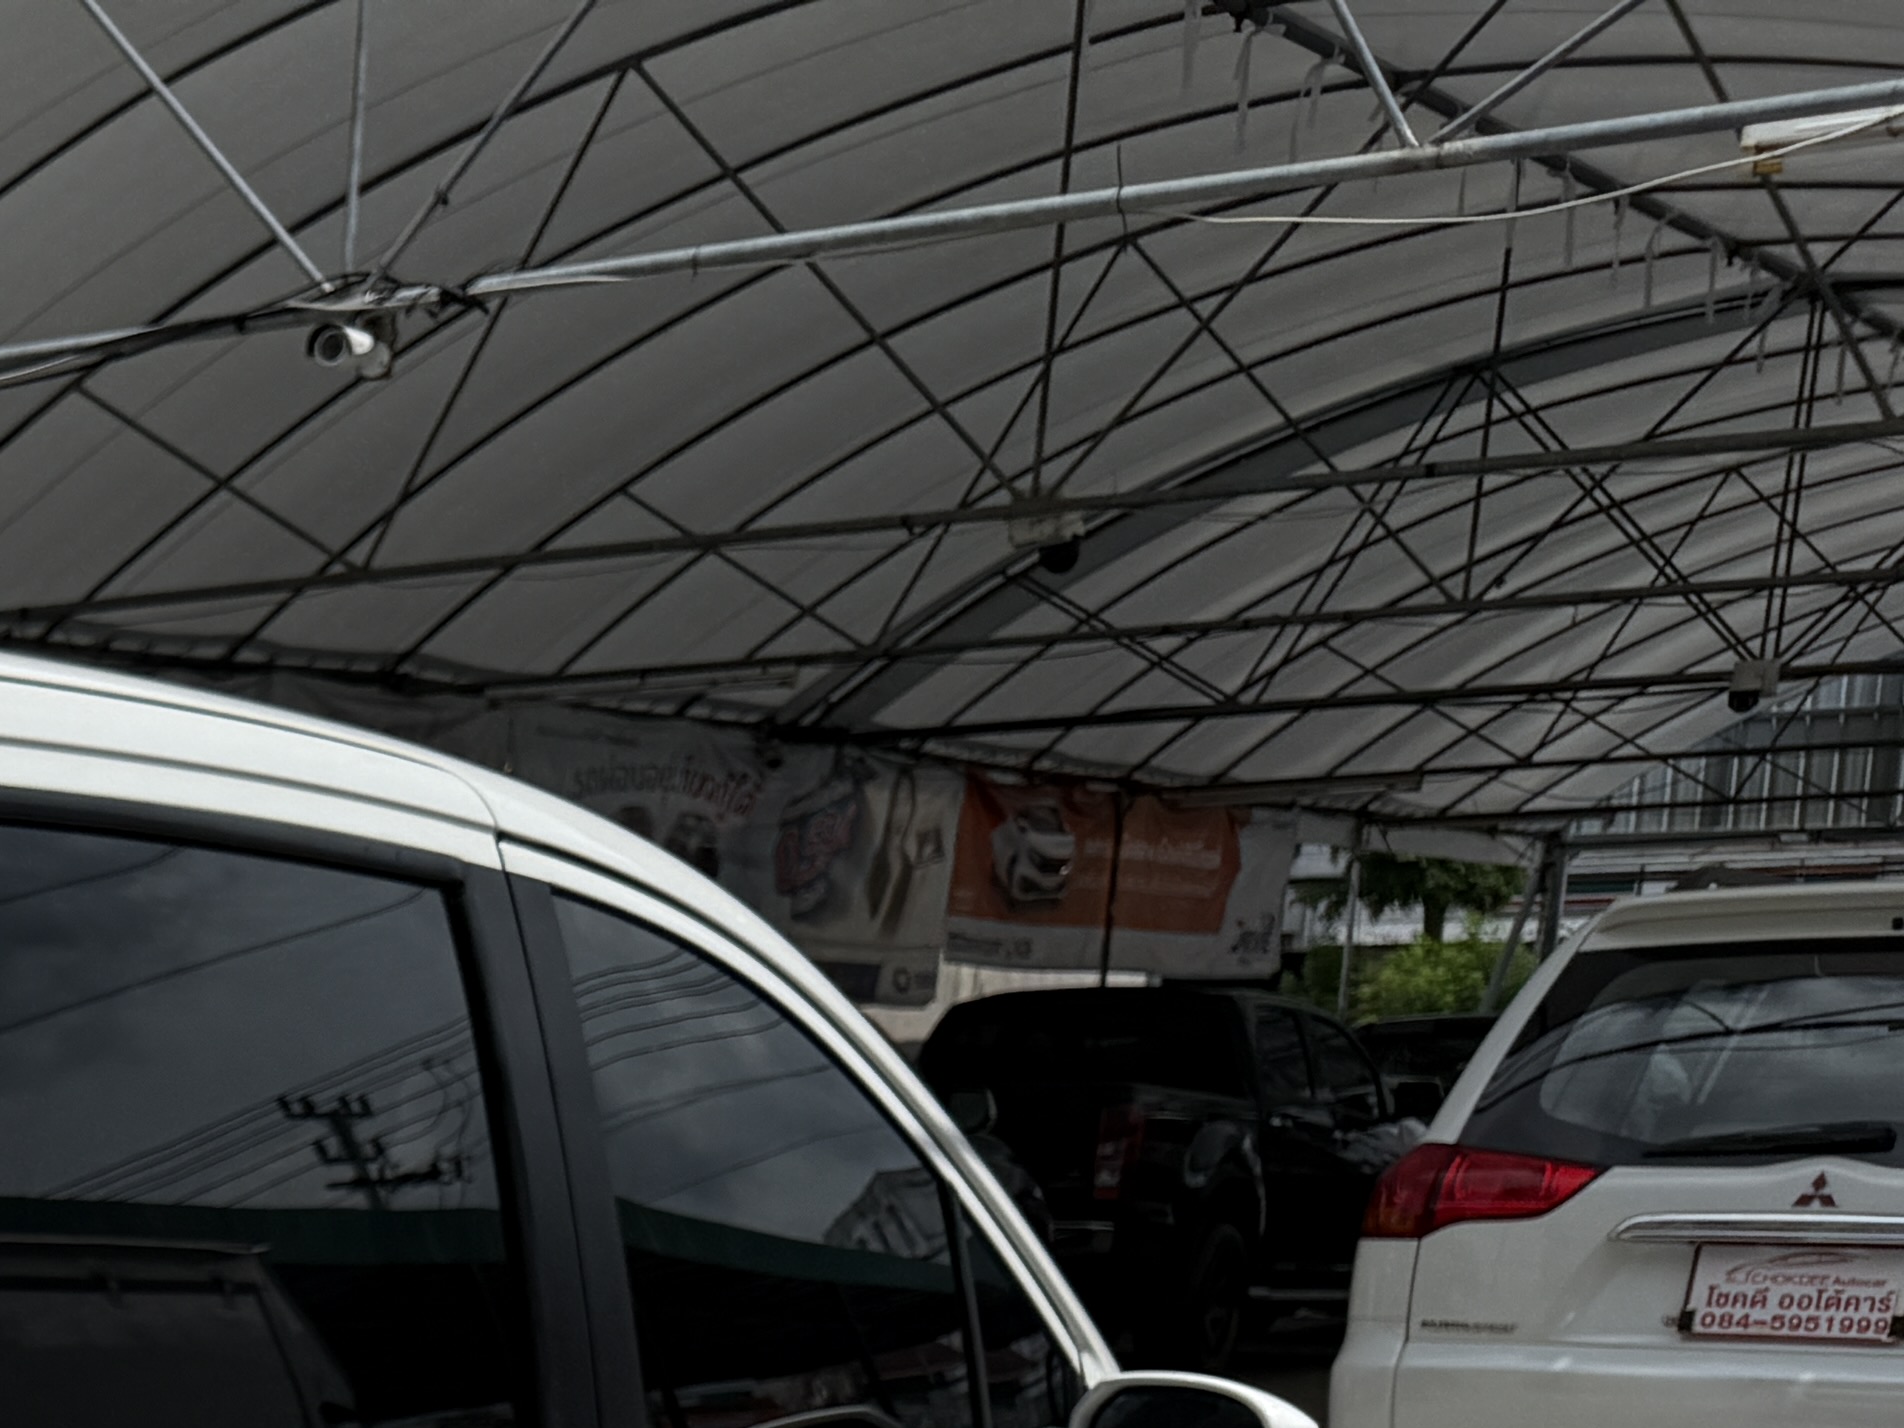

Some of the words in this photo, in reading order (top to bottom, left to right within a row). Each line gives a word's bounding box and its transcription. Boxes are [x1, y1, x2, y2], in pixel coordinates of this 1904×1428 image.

[1706, 1285, 1770, 1309] โชคดี
[1779, 1288, 1895, 1313] ออโต้คาร์
[1700, 1311, 1889, 1335] 084-5951999
